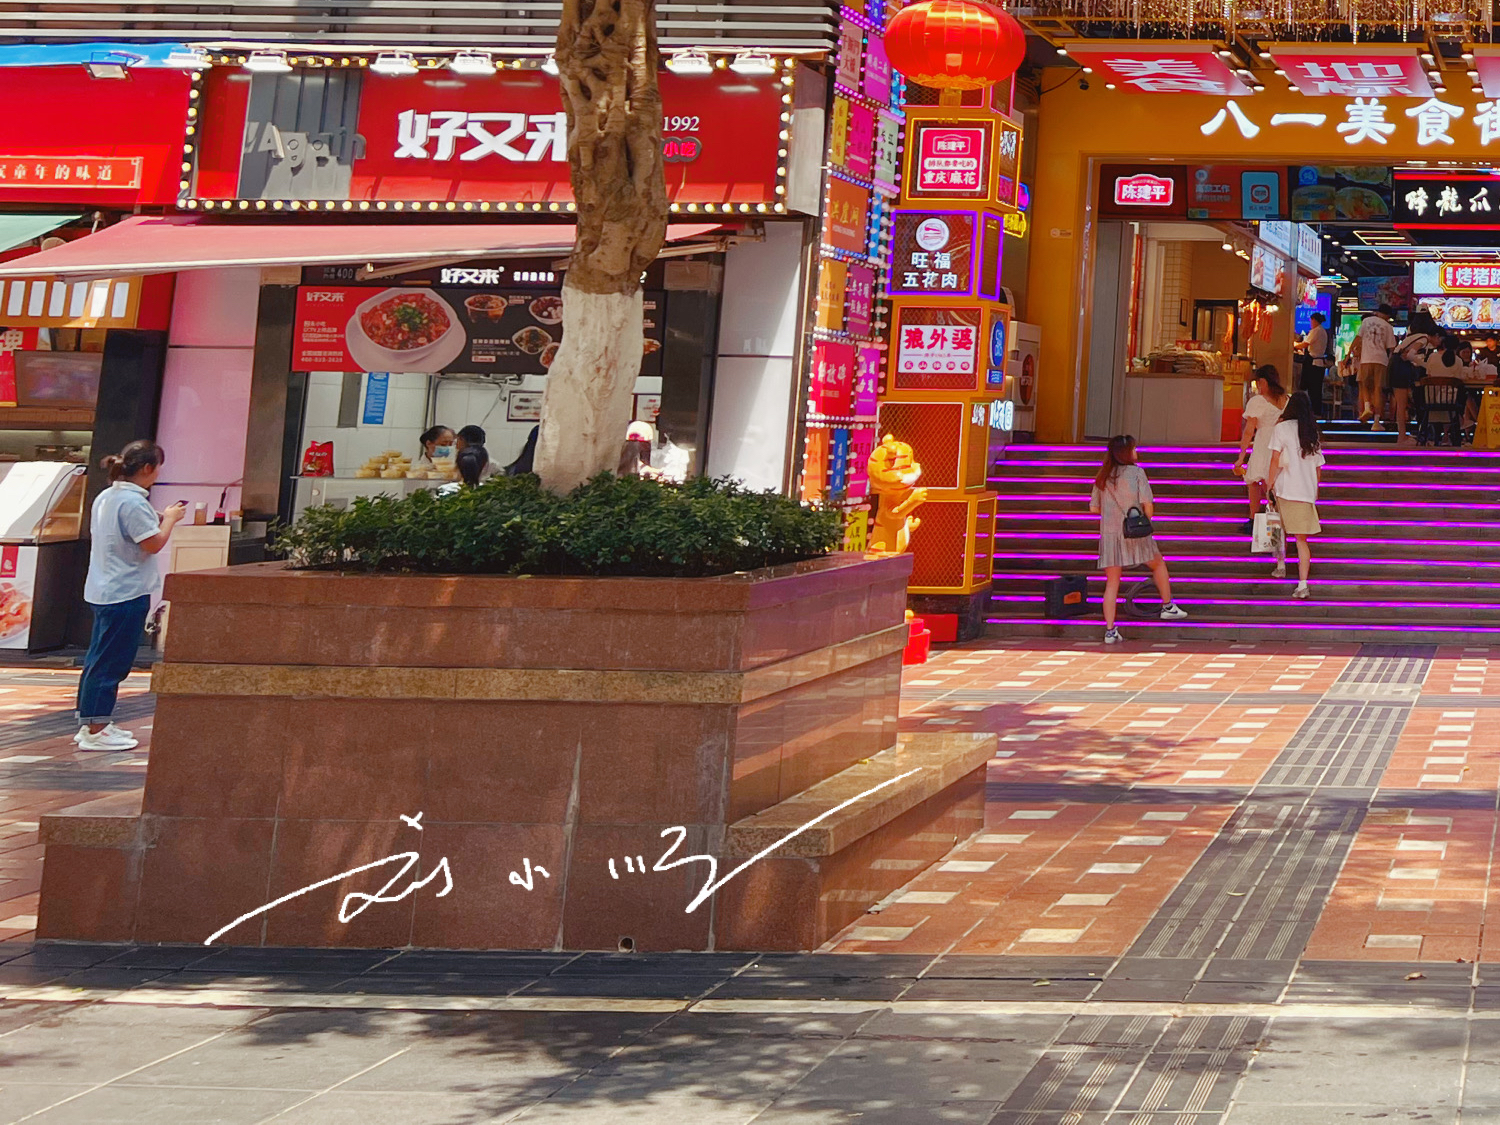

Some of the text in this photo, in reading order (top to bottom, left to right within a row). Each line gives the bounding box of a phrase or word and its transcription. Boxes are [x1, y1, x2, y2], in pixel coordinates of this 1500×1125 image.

[662, 115, 700, 132] 1992
[0, 163, 114, 182] 童年的味道
[922, 170, 977, 185] 重庆麻花
[1121, 184, 1167, 200] 陈建平
[911, 251, 951, 269] 旺福
[441, 268, 500, 286] 好又来
[902, 271, 959, 289] 五花肉
[306, 291, 345, 303] 好又来
[903, 327, 974, 351] 狼外婆
